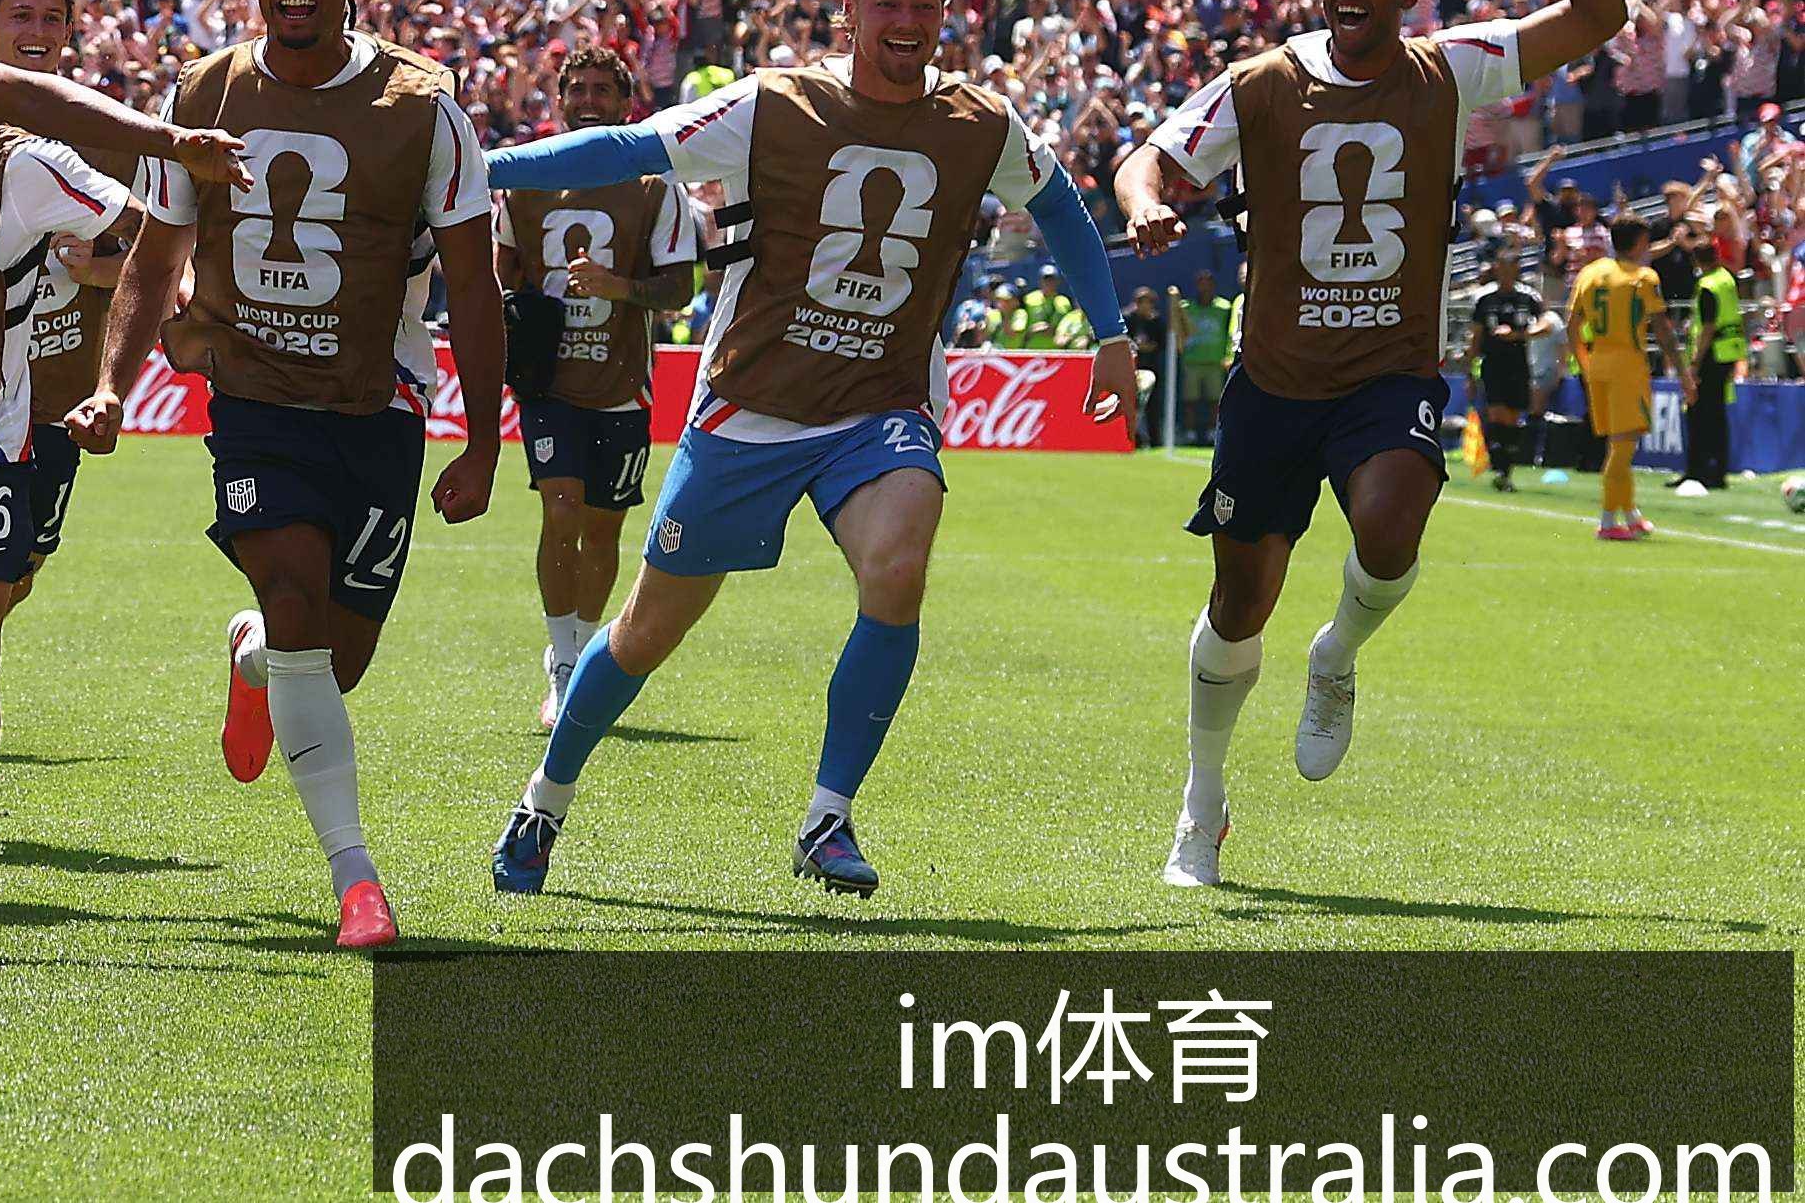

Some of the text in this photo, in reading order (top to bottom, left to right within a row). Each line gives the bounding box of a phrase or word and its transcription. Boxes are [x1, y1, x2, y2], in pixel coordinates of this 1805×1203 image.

[1330, 251, 1378, 269] FIFA
[259, 268, 310, 291] FIFA
[834, 277, 883, 303] FIFA
[1301, 286, 1402, 302] WORLD CUP
[52, 310, 82, 331] CUP
[234, 303, 340, 330] WORLD CUP
[794, 306, 895, 338] WORLD CUP
[1298, 304, 1402, 329] 2026
[27, 327, 83, 361] 026
[584, 331, 611, 342] CUP
[783, 324, 885, 361] 2026
[557, 342, 609, 363] 026
[1418, 399, 1436, 432] 6
[615, 447, 646, 490] 10
[227, 480, 255, 495] USA
[345, 507, 407, 578] 12
